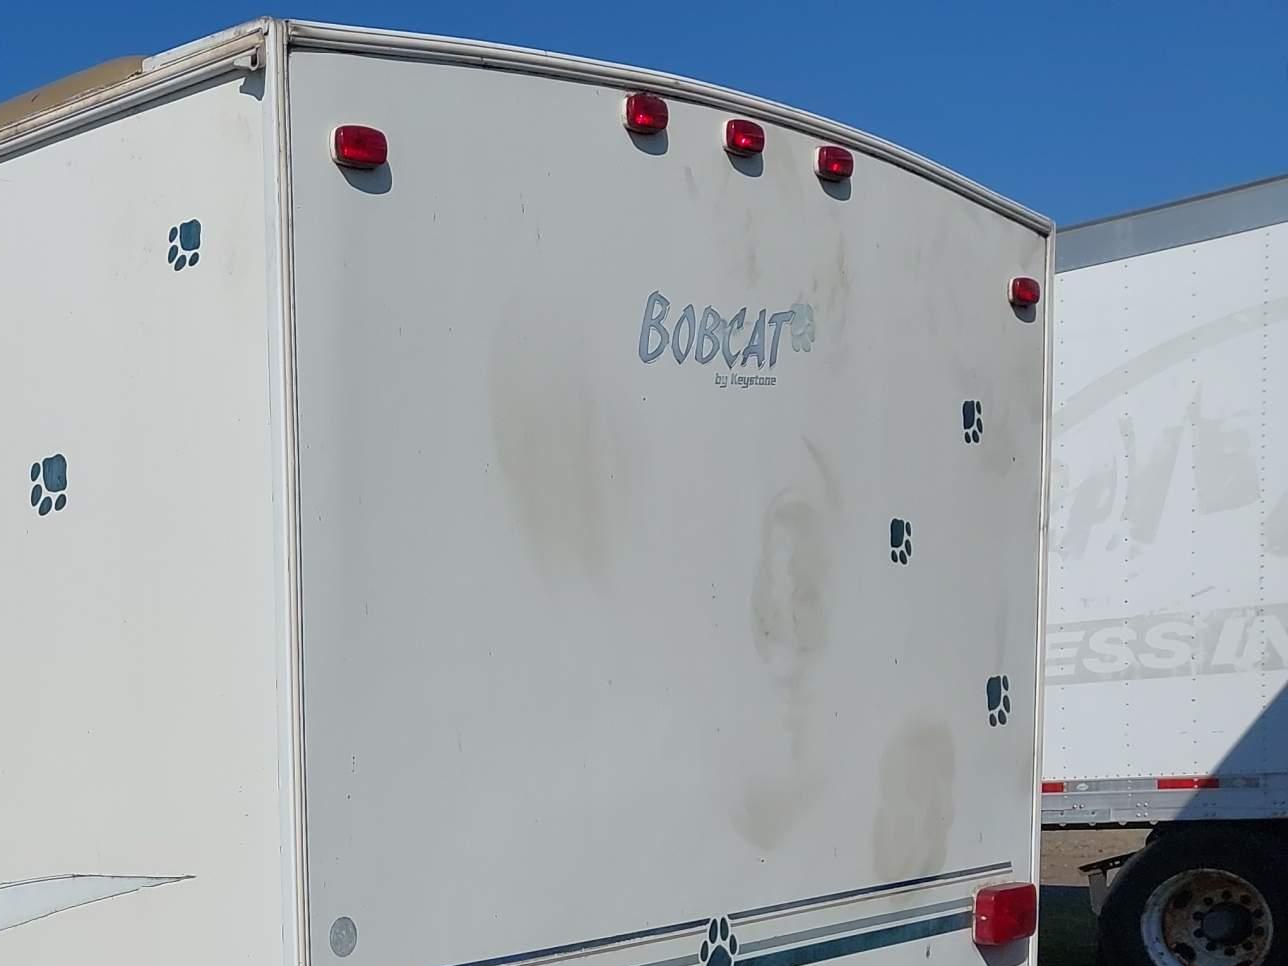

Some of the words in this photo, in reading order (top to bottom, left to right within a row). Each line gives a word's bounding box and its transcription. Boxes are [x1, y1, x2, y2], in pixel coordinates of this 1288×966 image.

[638, 290, 795, 369] BOBCAT
[714, 372, 728, 389] by
[730, 372, 777, 388] Keystone
